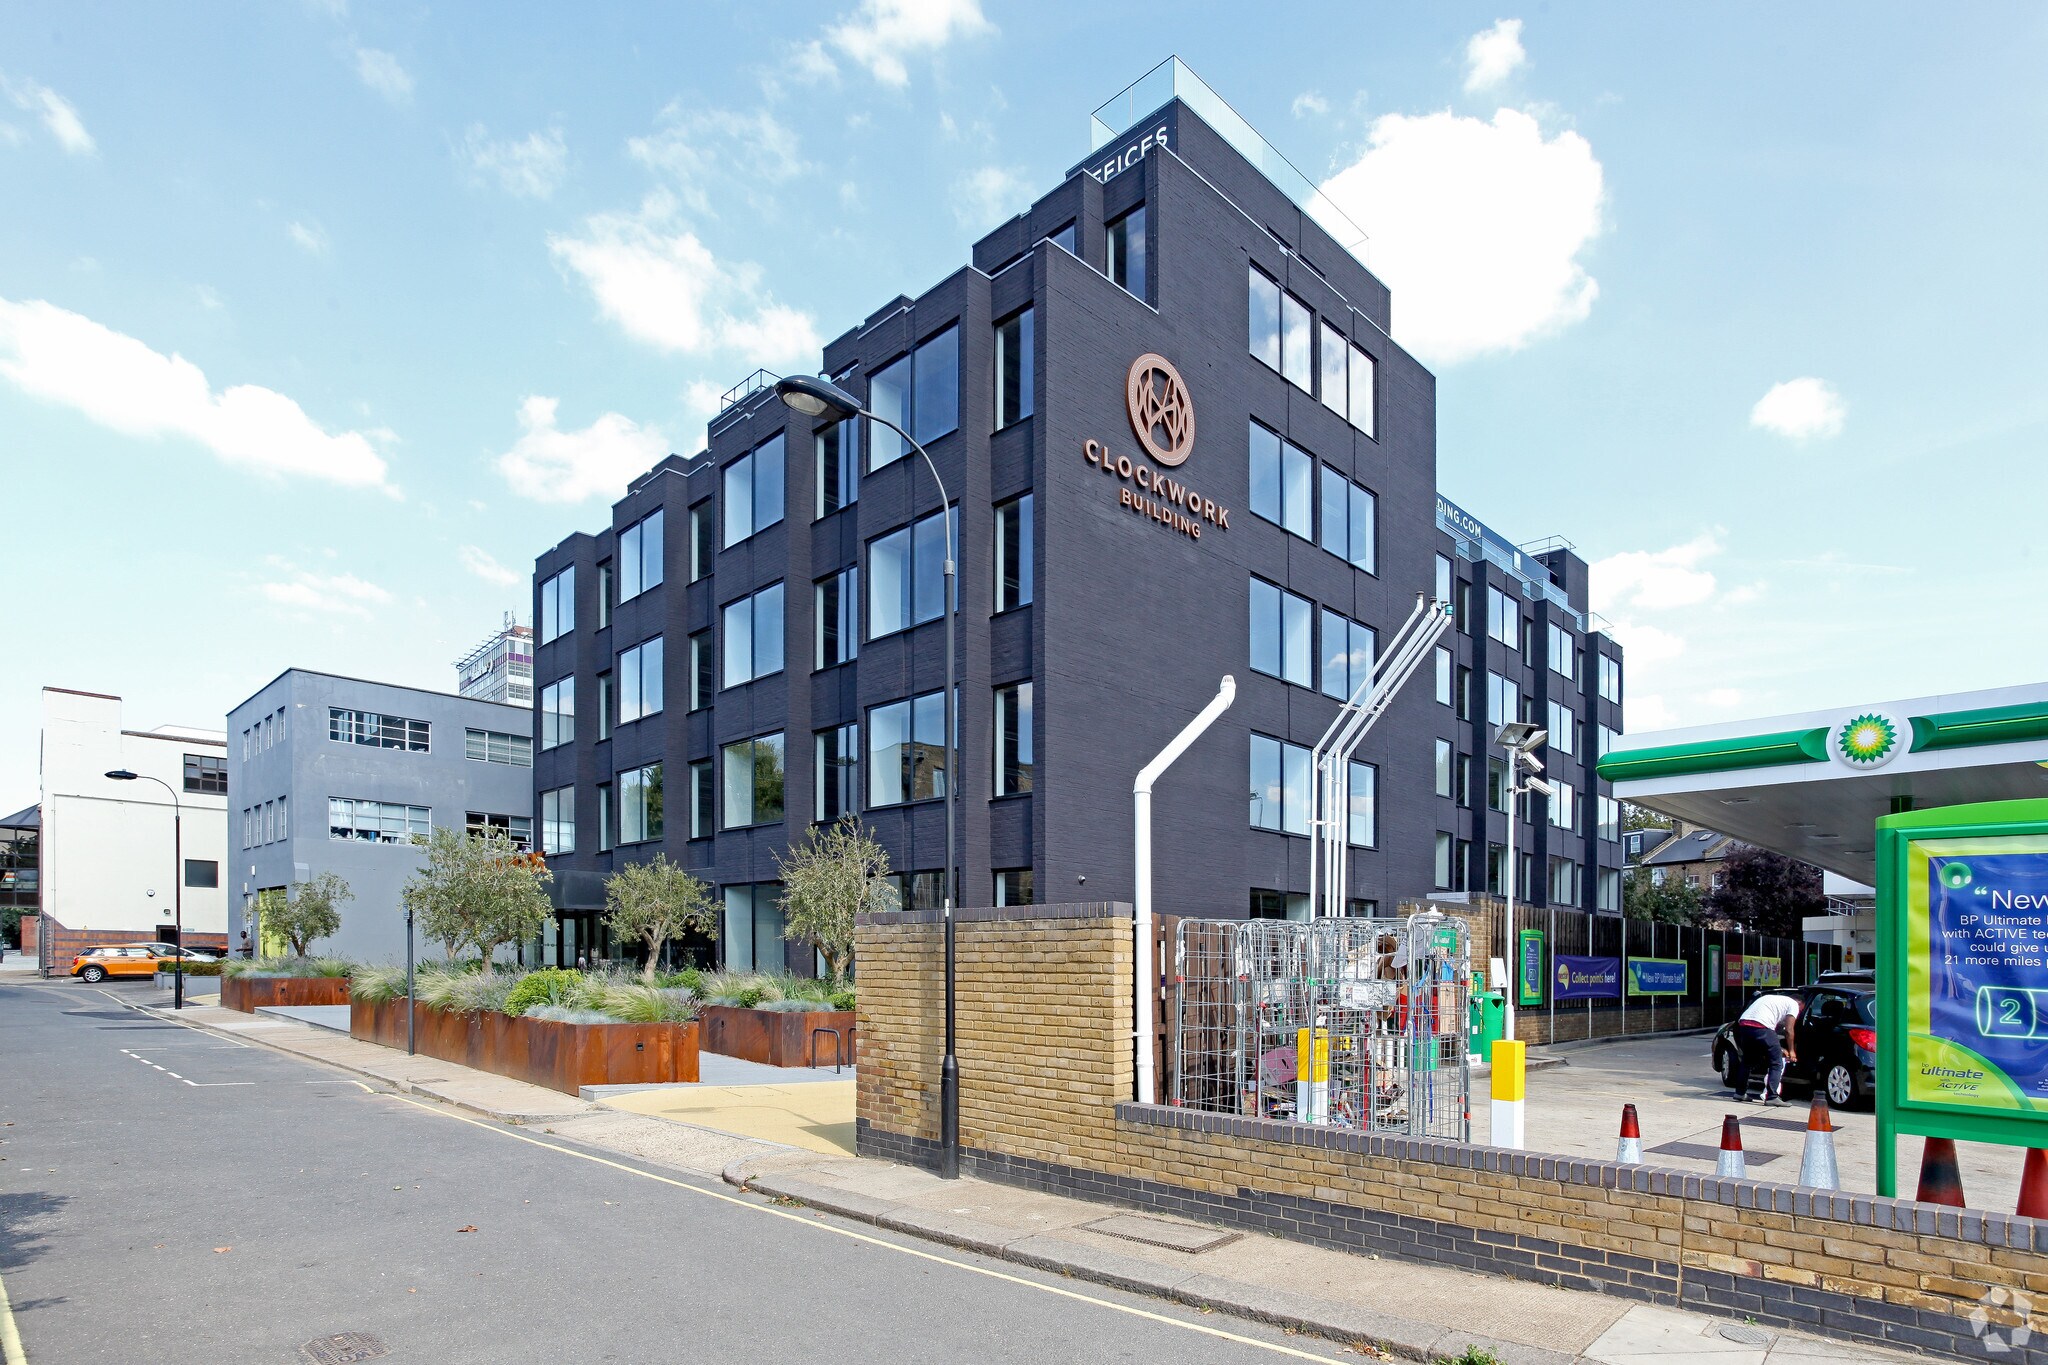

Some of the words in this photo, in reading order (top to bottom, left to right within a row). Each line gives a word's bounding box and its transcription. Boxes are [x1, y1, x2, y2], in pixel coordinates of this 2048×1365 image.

[1084, 439, 1230, 529] CLOCKWORK
[1120, 488, 1200, 538] BUILDING
[1960, 914, 1979, 926] BP
[1983, 914, 2041, 926] Ultimate
[1942, 928, 1970, 939] with
[1974, 928, 2028, 939] ACTIVE
[1970, 942, 2006, 952] could
[2010, 942, 2039, 955] give
[1944, 954, 1958, 965] 21
[1965, 956, 1999, 966] more
[2004, 955, 2041, 967] miles
[1571, 971, 1589, 984] Collect
[1589, 971, 1604, 988] points
[2000, 998, 2022, 1025] 2
[1921, 1066, 1984, 1079] ultimate
[1937, 1082, 1979, 1091] ACTIVE
